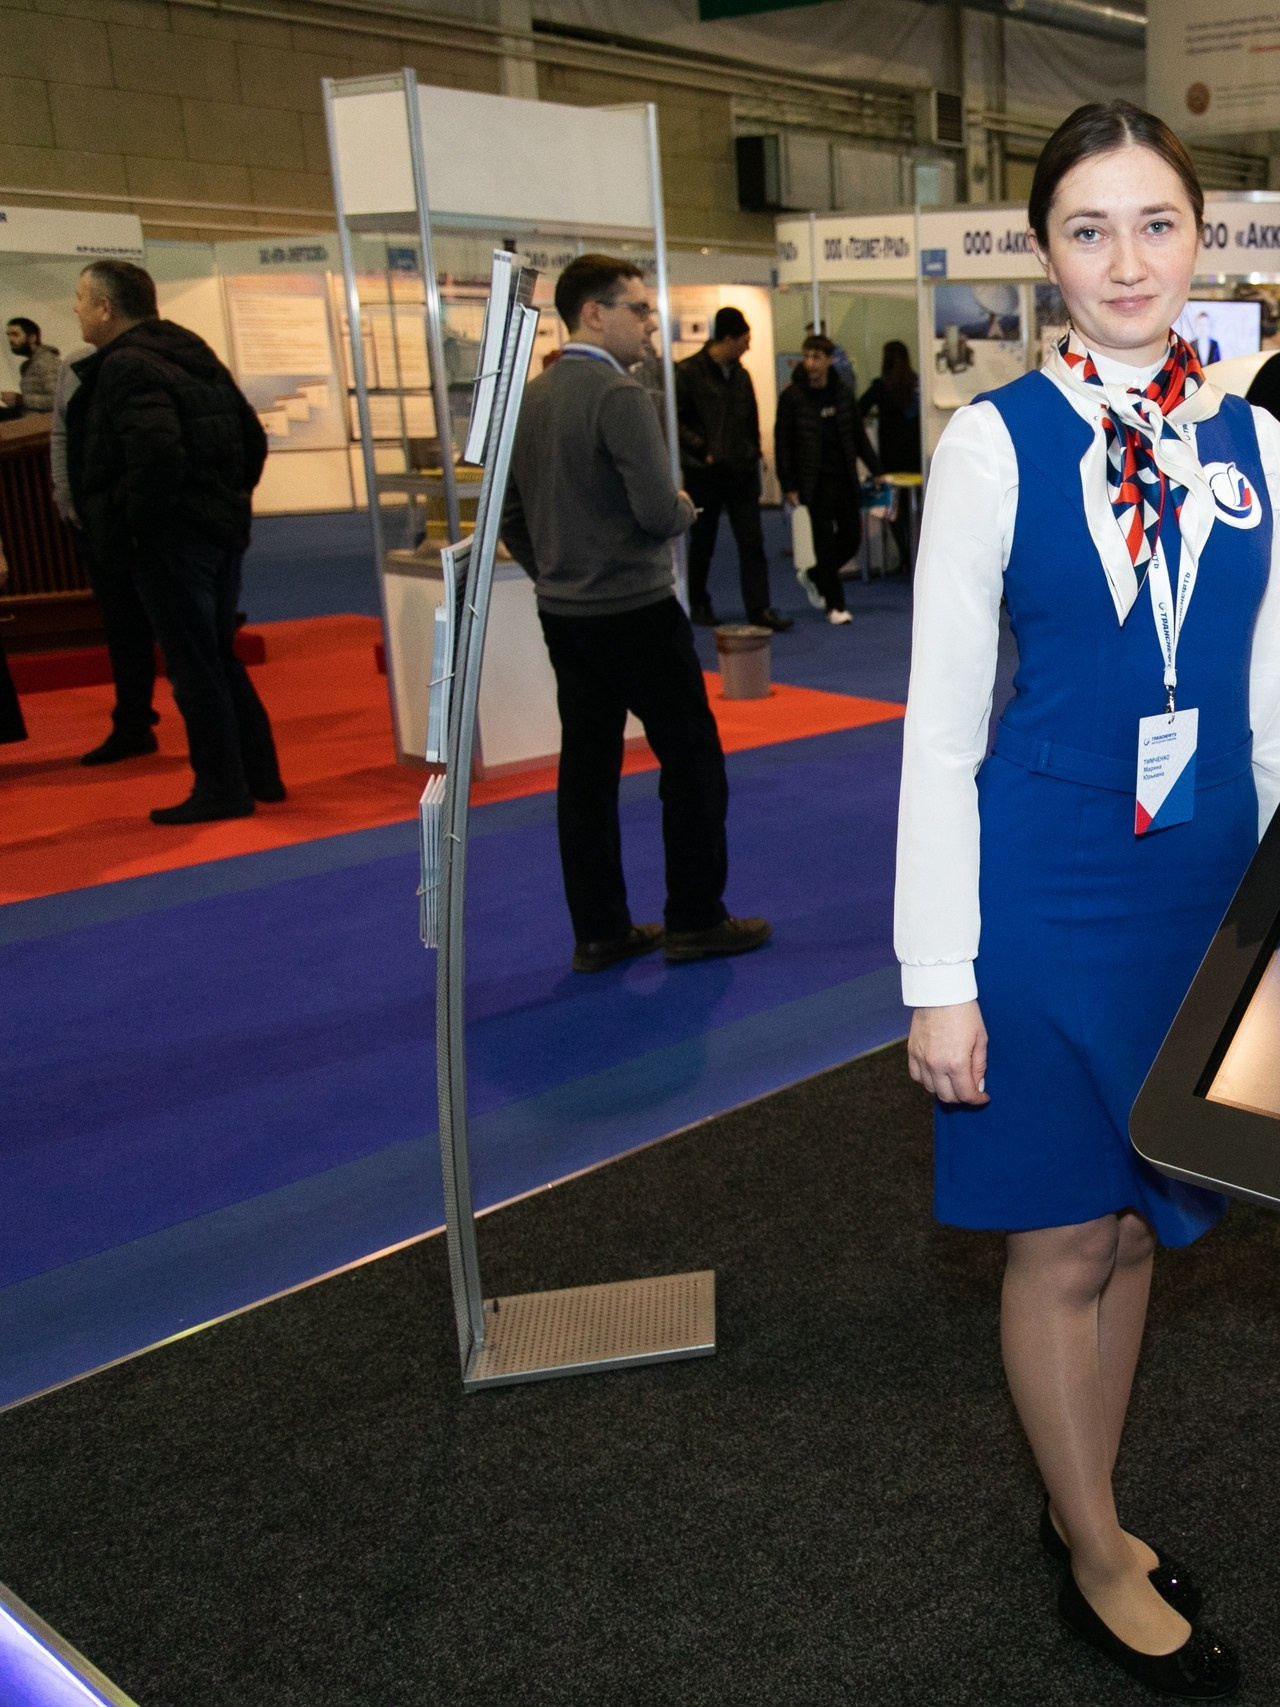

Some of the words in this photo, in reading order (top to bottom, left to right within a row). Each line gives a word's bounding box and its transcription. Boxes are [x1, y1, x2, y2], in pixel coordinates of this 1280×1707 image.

[963, 230, 993, 255] ООО
[1202, 222, 1228, 249] ОО
[1178, 571, 1191, 634] НСНЕФТЬ
[1143, 765, 1162, 773] Марина
[1143, 772, 1165, 781] Юрьевна
